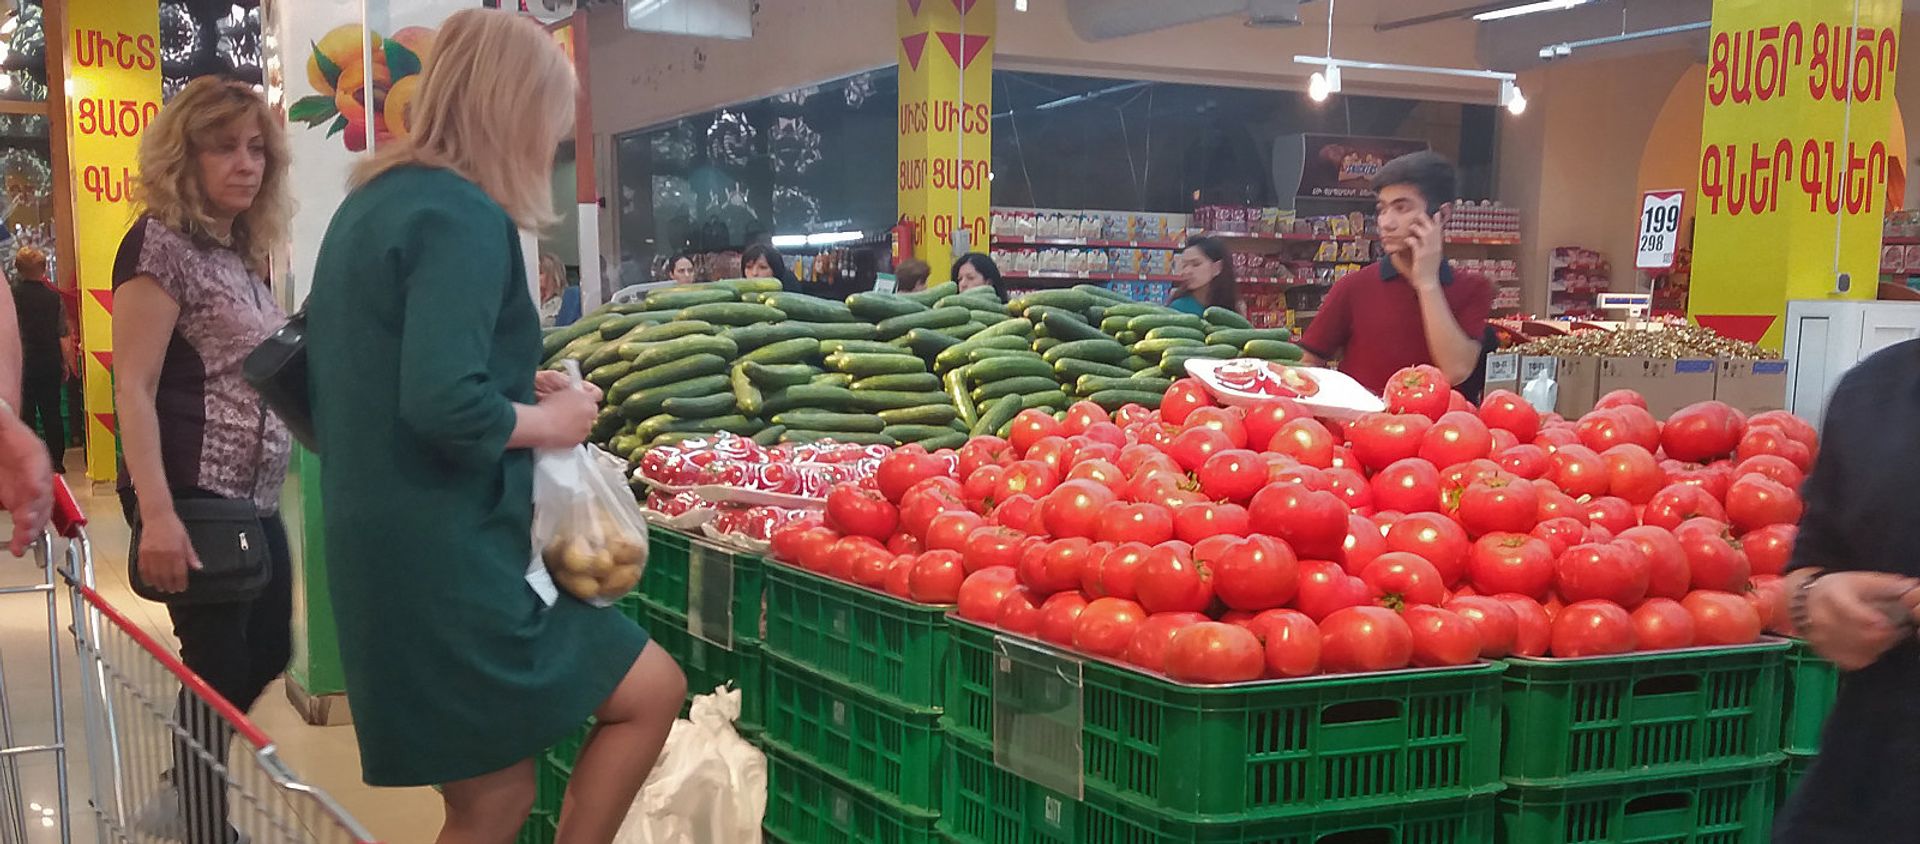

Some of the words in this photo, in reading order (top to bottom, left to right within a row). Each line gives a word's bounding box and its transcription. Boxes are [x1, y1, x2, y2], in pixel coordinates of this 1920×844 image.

[75, 29, 156, 71] ՄԻՇՏ
[1708, 21, 1803, 106] ՑԱԾՐ
[1809, 22, 1896, 105] ՑԱԾՐ
[900, 101, 928, 135] ՄԻՇՏ
[934, 100, 988, 134] ՄԻՇՏ
[900, 159, 928, 191] ՑԱԾՐ
[933, 158, 989, 191] ՑԱԾՐ
[1701, 138, 1793, 216] ԳՆԵՐ
[1800, 138, 1886, 215] ԳՆԵՐ
[1645, 205, 1679, 233] 199
[1640, 234, 1664, 252] 298
